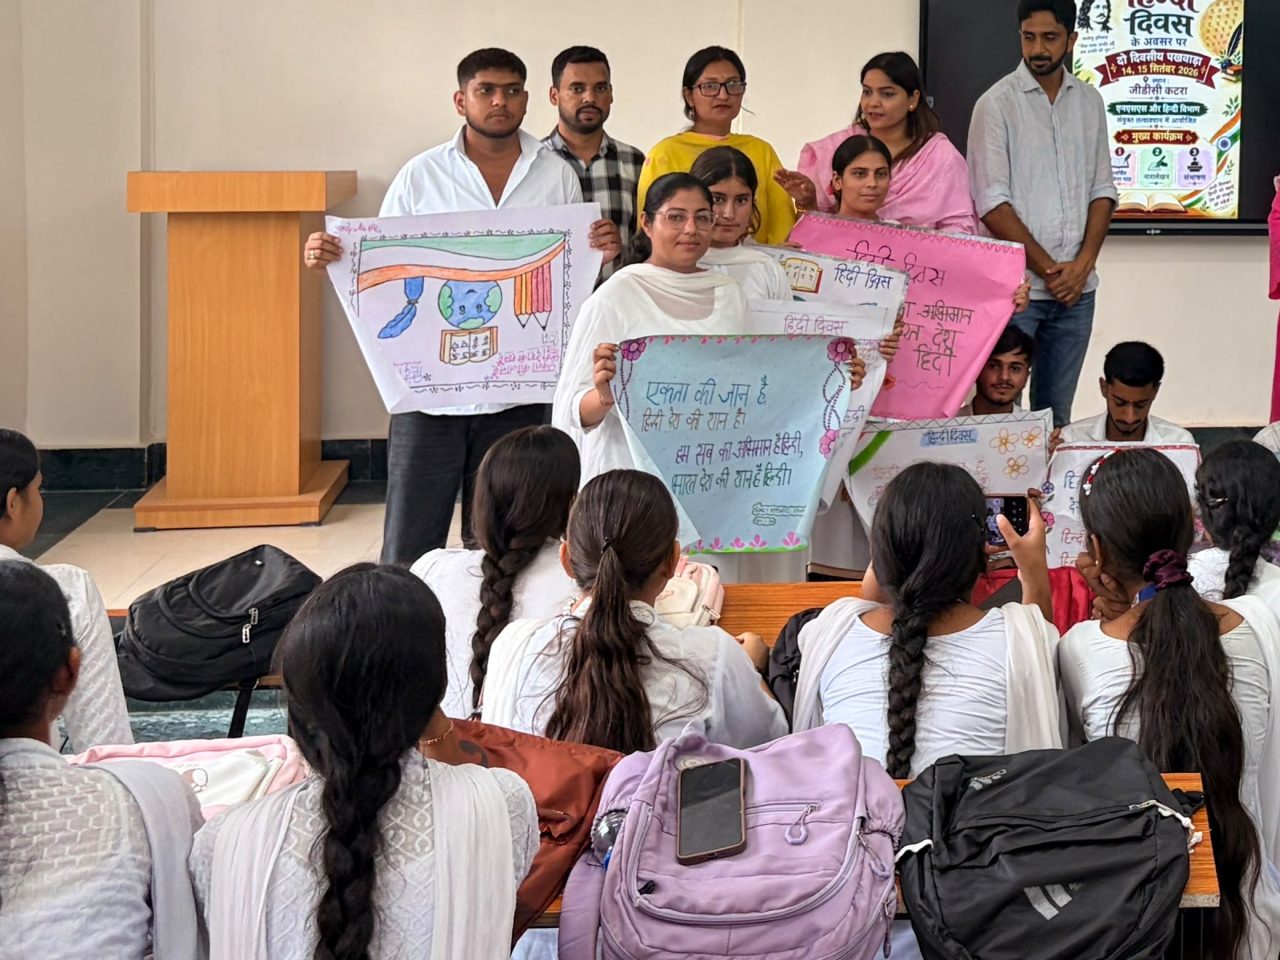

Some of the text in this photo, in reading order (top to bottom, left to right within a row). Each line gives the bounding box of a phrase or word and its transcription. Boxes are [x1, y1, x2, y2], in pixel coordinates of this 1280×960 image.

[1124, 9, 1195, 37] दिवस
[1130, 37, 1187, 47] के अवसर पर
[1116, 53, 1128, 65] दो
[1129, 50, 1163, 63] दिवसीय
[1137, 65, 1147, 73] 15
[1149, 63, 1176, 74] सितंबर
[1129, 83, 1188, 96] जीडीसी कटरा
[1116, 103, 1200, 114] एनएसएस और हिन्दी विभाग
[1131, 129, 1184, 144] मुख्य कार्यक्रम
[815, 315, 848, 335] दिवस
[932, 322, 965, 352] देश
[913, 343, 957, 377] हिंदी
[646, 375, 769, 407] एकता की जान है
[642, 408, 665, 433] हिन्दी
[686, 408, 704, 432] की
[675, 445, 690, 464] हम
[696, 443, 714, 466] सब
[671, 473, 698, 496] भारत
[716, 467, 730, 489] की
